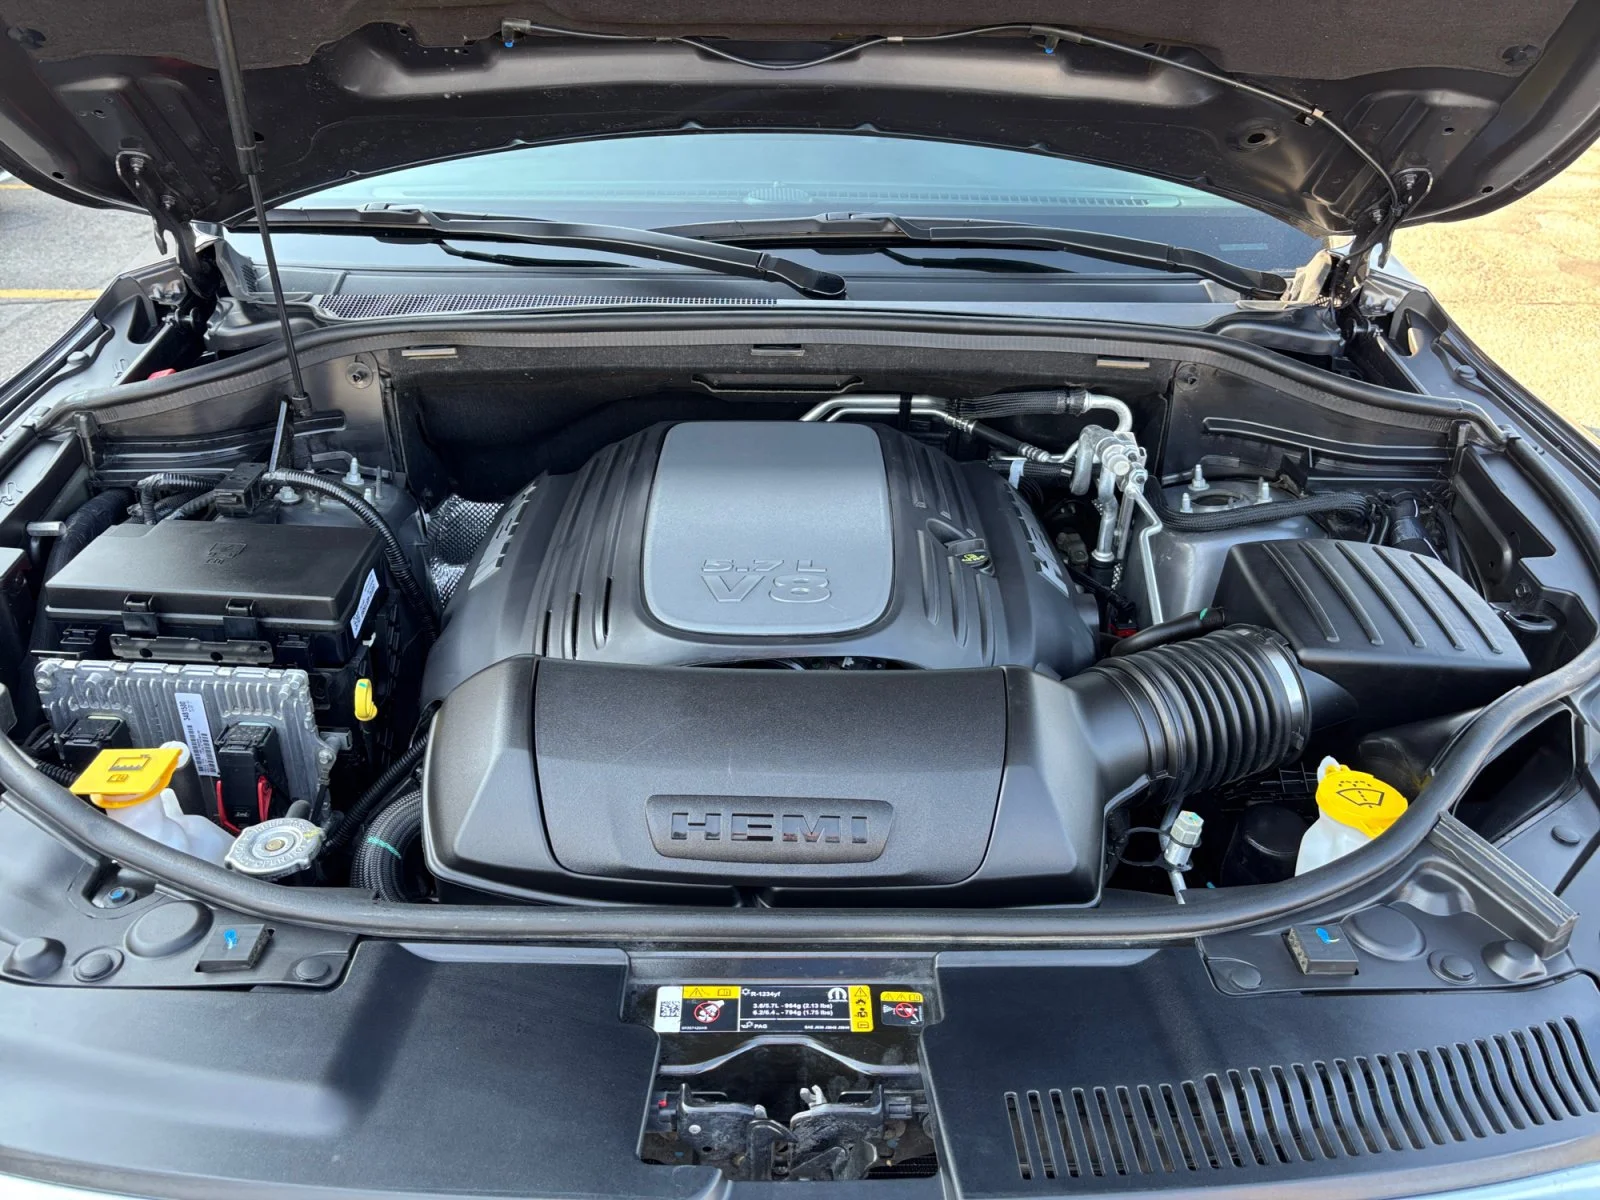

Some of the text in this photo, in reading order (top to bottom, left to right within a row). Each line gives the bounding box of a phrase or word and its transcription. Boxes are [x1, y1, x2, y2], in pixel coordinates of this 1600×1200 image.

[701, 558, 828, 572] 5.7 L
[700, 574, 832, 603] V8
[671, 812, 867, 843] HEMI
